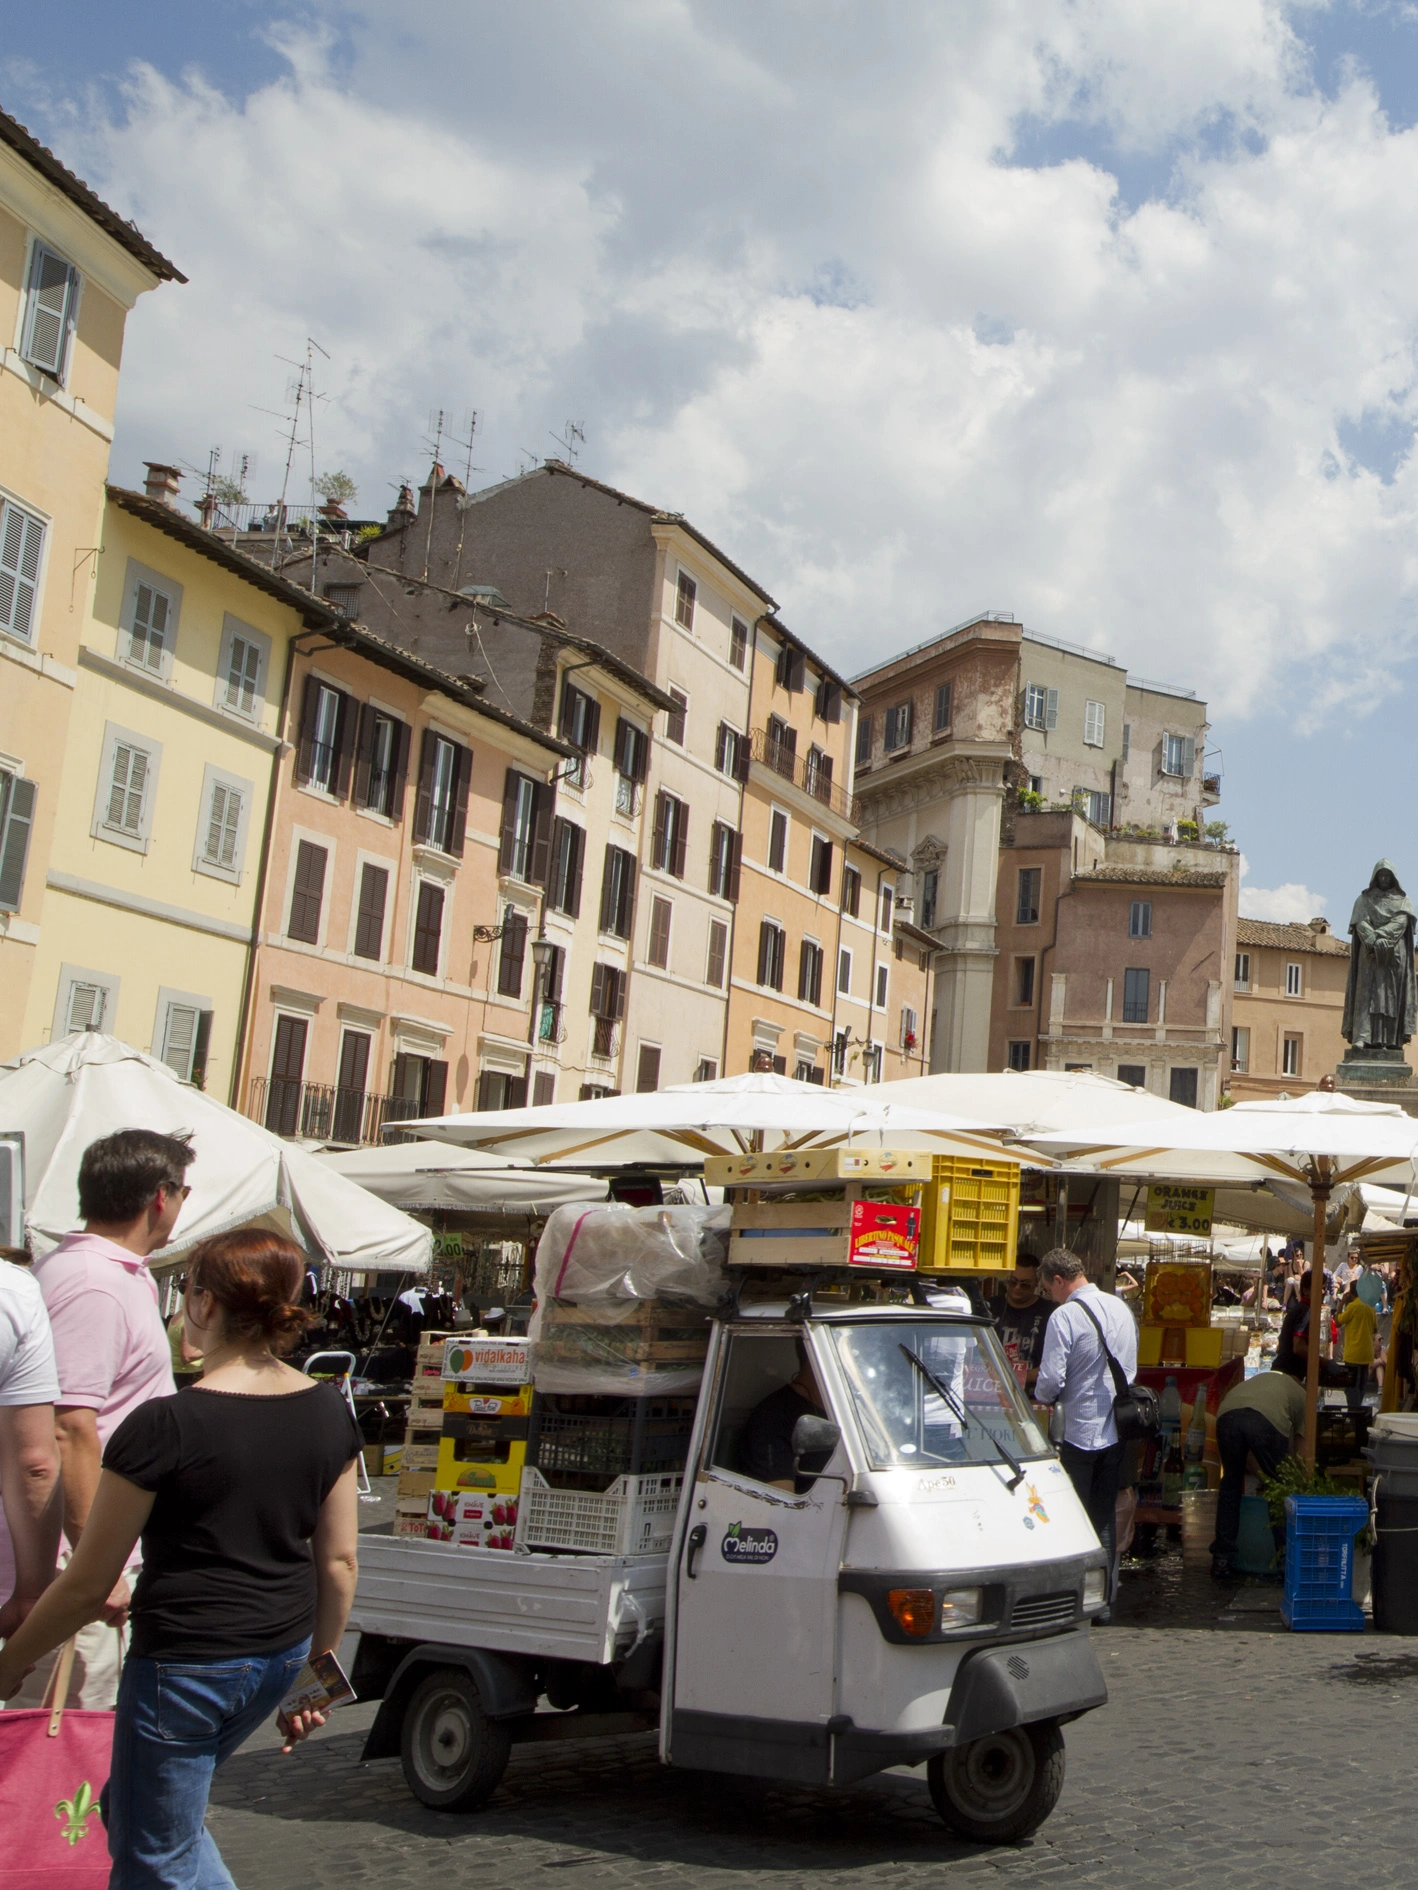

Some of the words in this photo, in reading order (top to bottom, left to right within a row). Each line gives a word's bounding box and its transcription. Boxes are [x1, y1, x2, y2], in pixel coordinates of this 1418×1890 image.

[1154, 1186, 1208, 1200] ORANGE
[1161, 1199, 1197, 1212] JUICE
[1178, 1215, 1210, 1231] 3.00
[475, 1349, 525, 1365] vidalkaha
[963, 1378, 1002, 1392] UICE
[409, 1522, 426, 1534] TOT
[723, 1535, 775, 1553] Melinda
